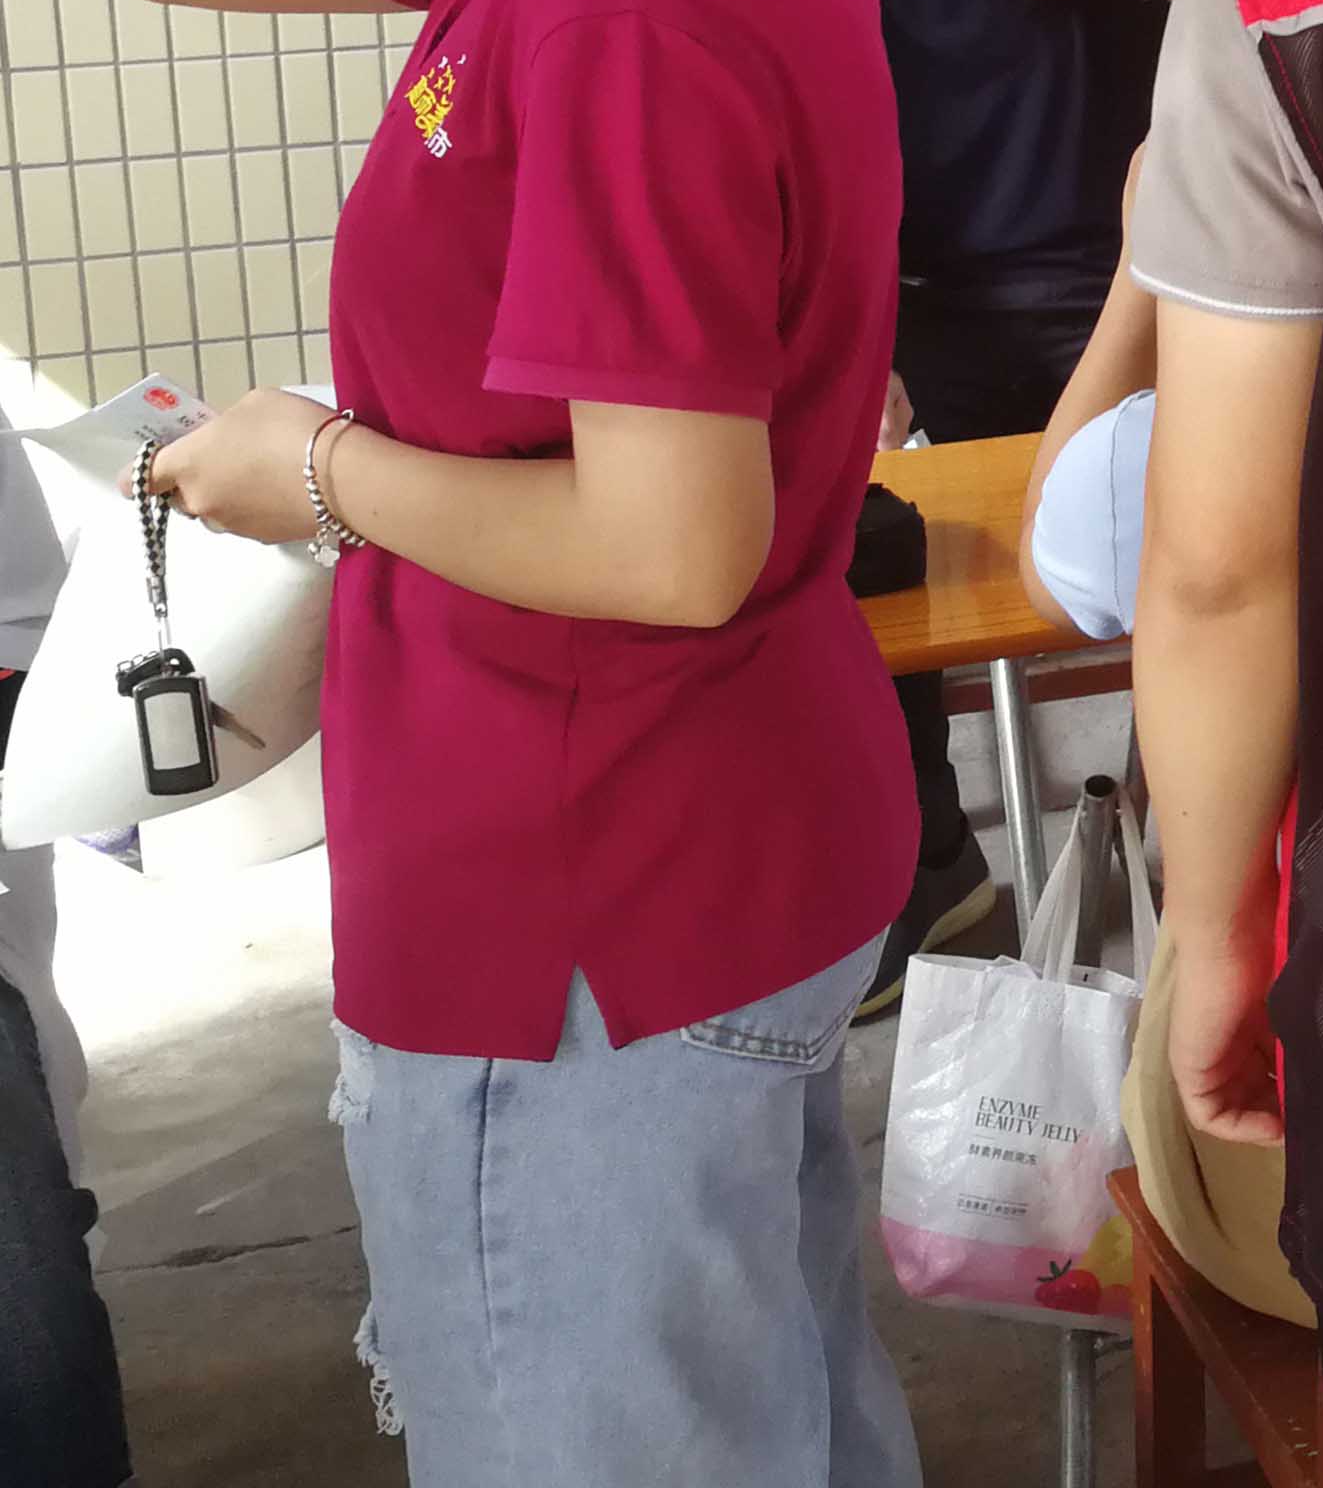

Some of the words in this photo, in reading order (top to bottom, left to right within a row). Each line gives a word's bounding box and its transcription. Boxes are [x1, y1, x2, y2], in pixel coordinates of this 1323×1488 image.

[978, 1095, 1043, 1120] ENZYME
[976, 1111, 1038, 1136] BEAUTY
[1041, 1123, 1083, 1143] JELLY
